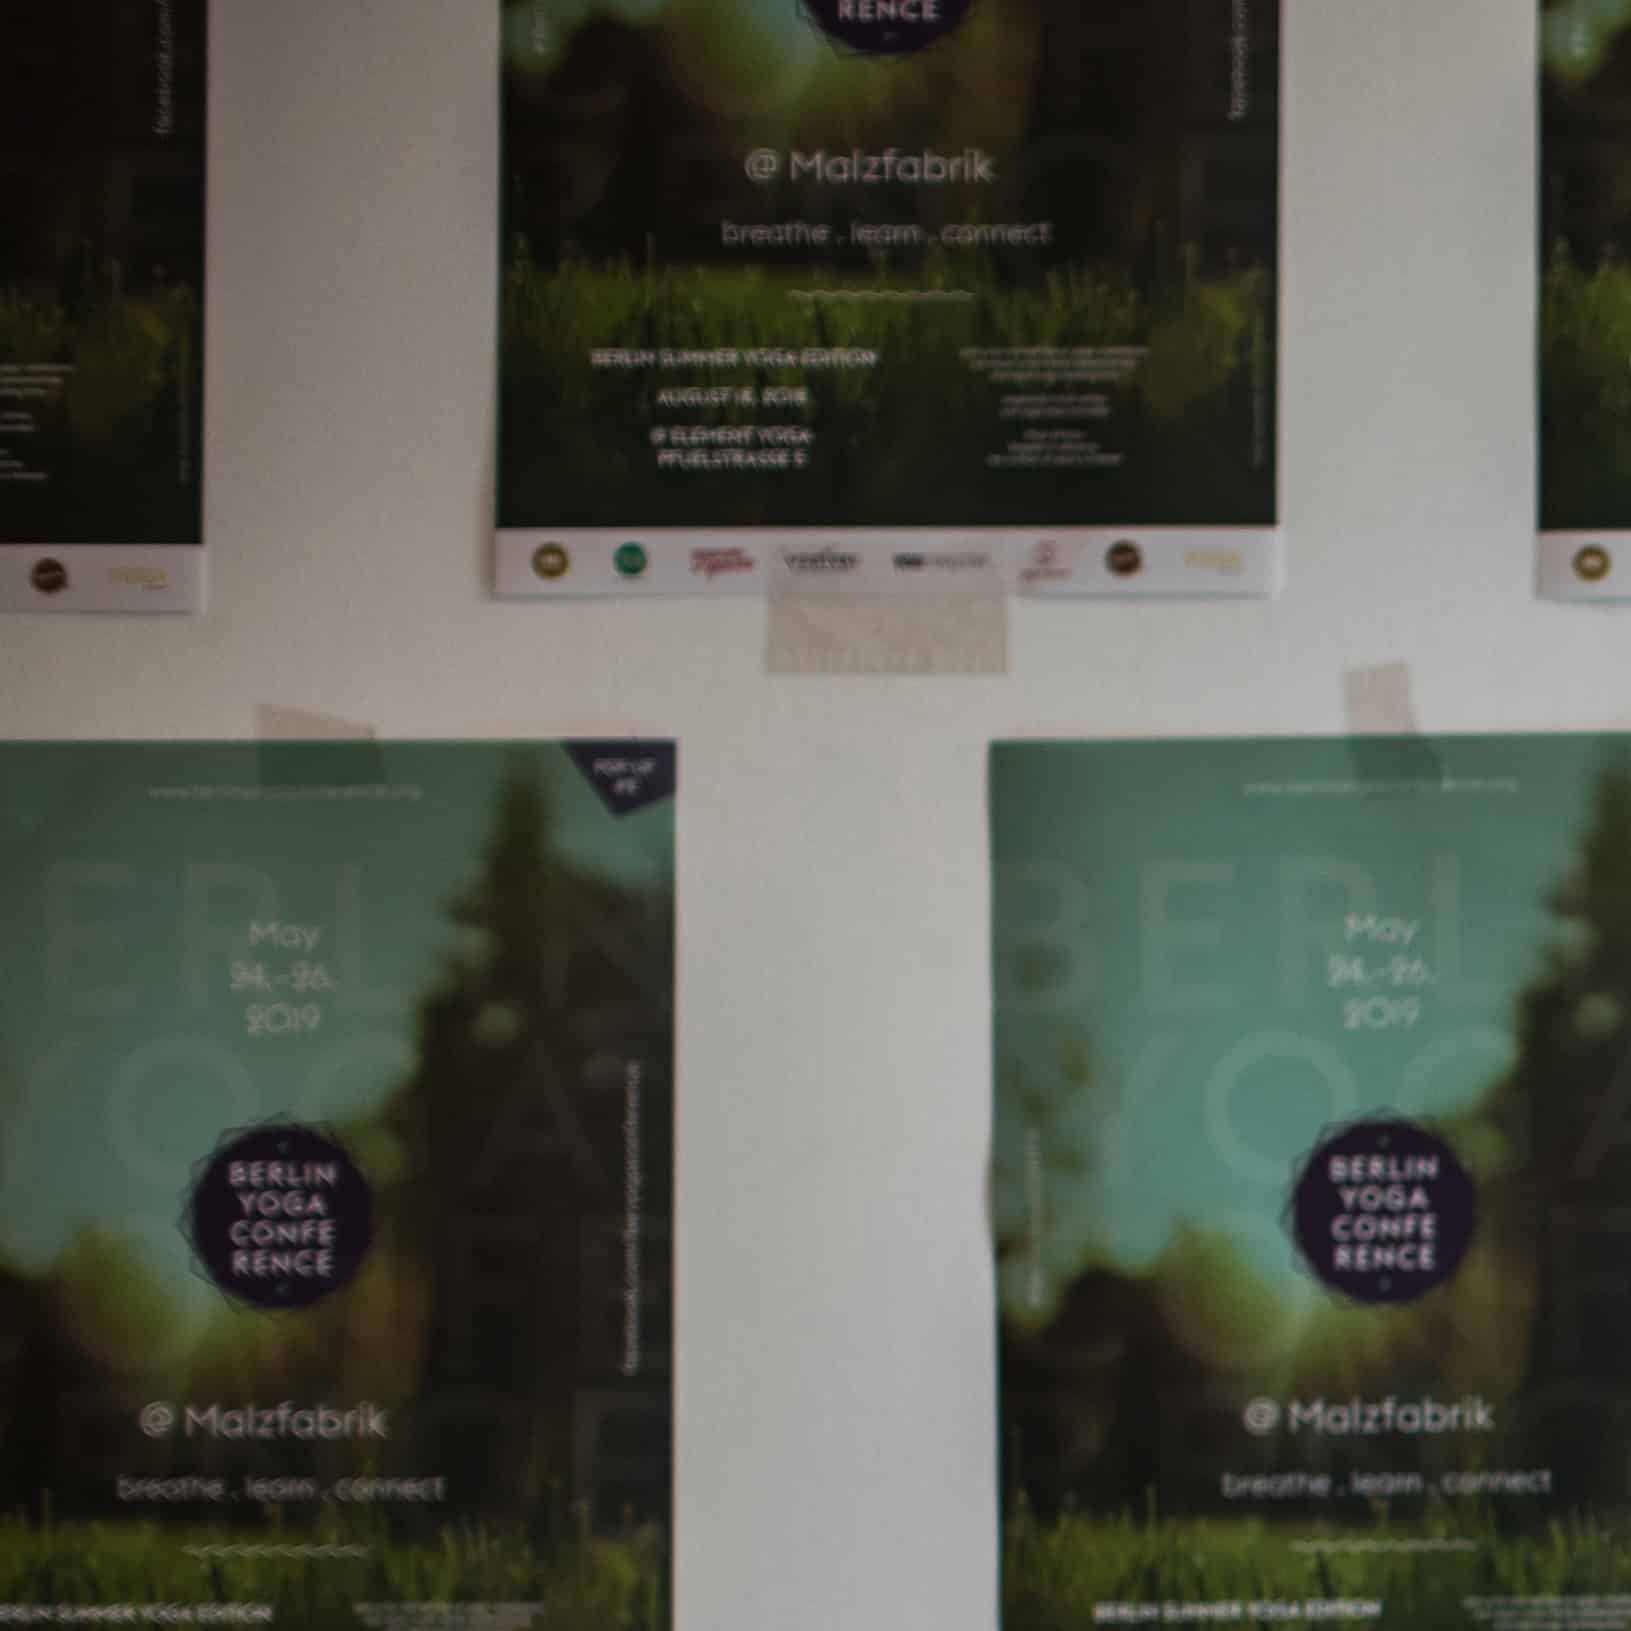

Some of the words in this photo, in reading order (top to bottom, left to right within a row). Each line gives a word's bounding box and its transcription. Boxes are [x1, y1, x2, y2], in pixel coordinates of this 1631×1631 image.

[743, 147, 781, 185] @
[788, 145, 996, 185] Malzfabrik
[721, 220, 832, 246] breathe
[848, 217, 923, 244] learn
[938, 219, 1053, 245] connect
[247, 918, 320, 953] May
[1344, 912, 1418, 948] May
[244, 1002, 321, 1034] 2019
[1343, 996, 1420, 1029] 2019
[227, 1158, 338, 1187] BERLIN
[1328, 1152, 1440, 1182] BERLIN
[236, 1189, 329, 1217] YOGA
[1337, 1182, 1431, 1212] YOGA
[227, 1218, 336, 1247] CONFE
[1329, 1212, 1439, 1242] CONFE
[229, 1247, 335, 1278] RENCE
[1332, 1241, 1438, 1273] RENCE
[138, 1401, 177, 1439] @
[184, 1400, 391, 1440] Malzfabrik
[1243, 1398, 1281, 1436] @
[1288, 1394, 1497, 1436] Malzfabrik
[116, 1475, 227, 1500] breathe
[243, 1473, 318, 1499] learn
[333, 1475, 448, 1500] connect
[1222, 1471, 1333, 1497] breathe
[1349, 1467, 1424, 1494] learn
[1439, 1467, 1555, 1494] connect
[1091, 1601, 1159, 1623] BERLIN
[1162, 1599, 1242, 1622] SUMMER
[1247, 1599, 1300, 1620] YOGA
[1303, 1597, 1383, 1619] EDITION
